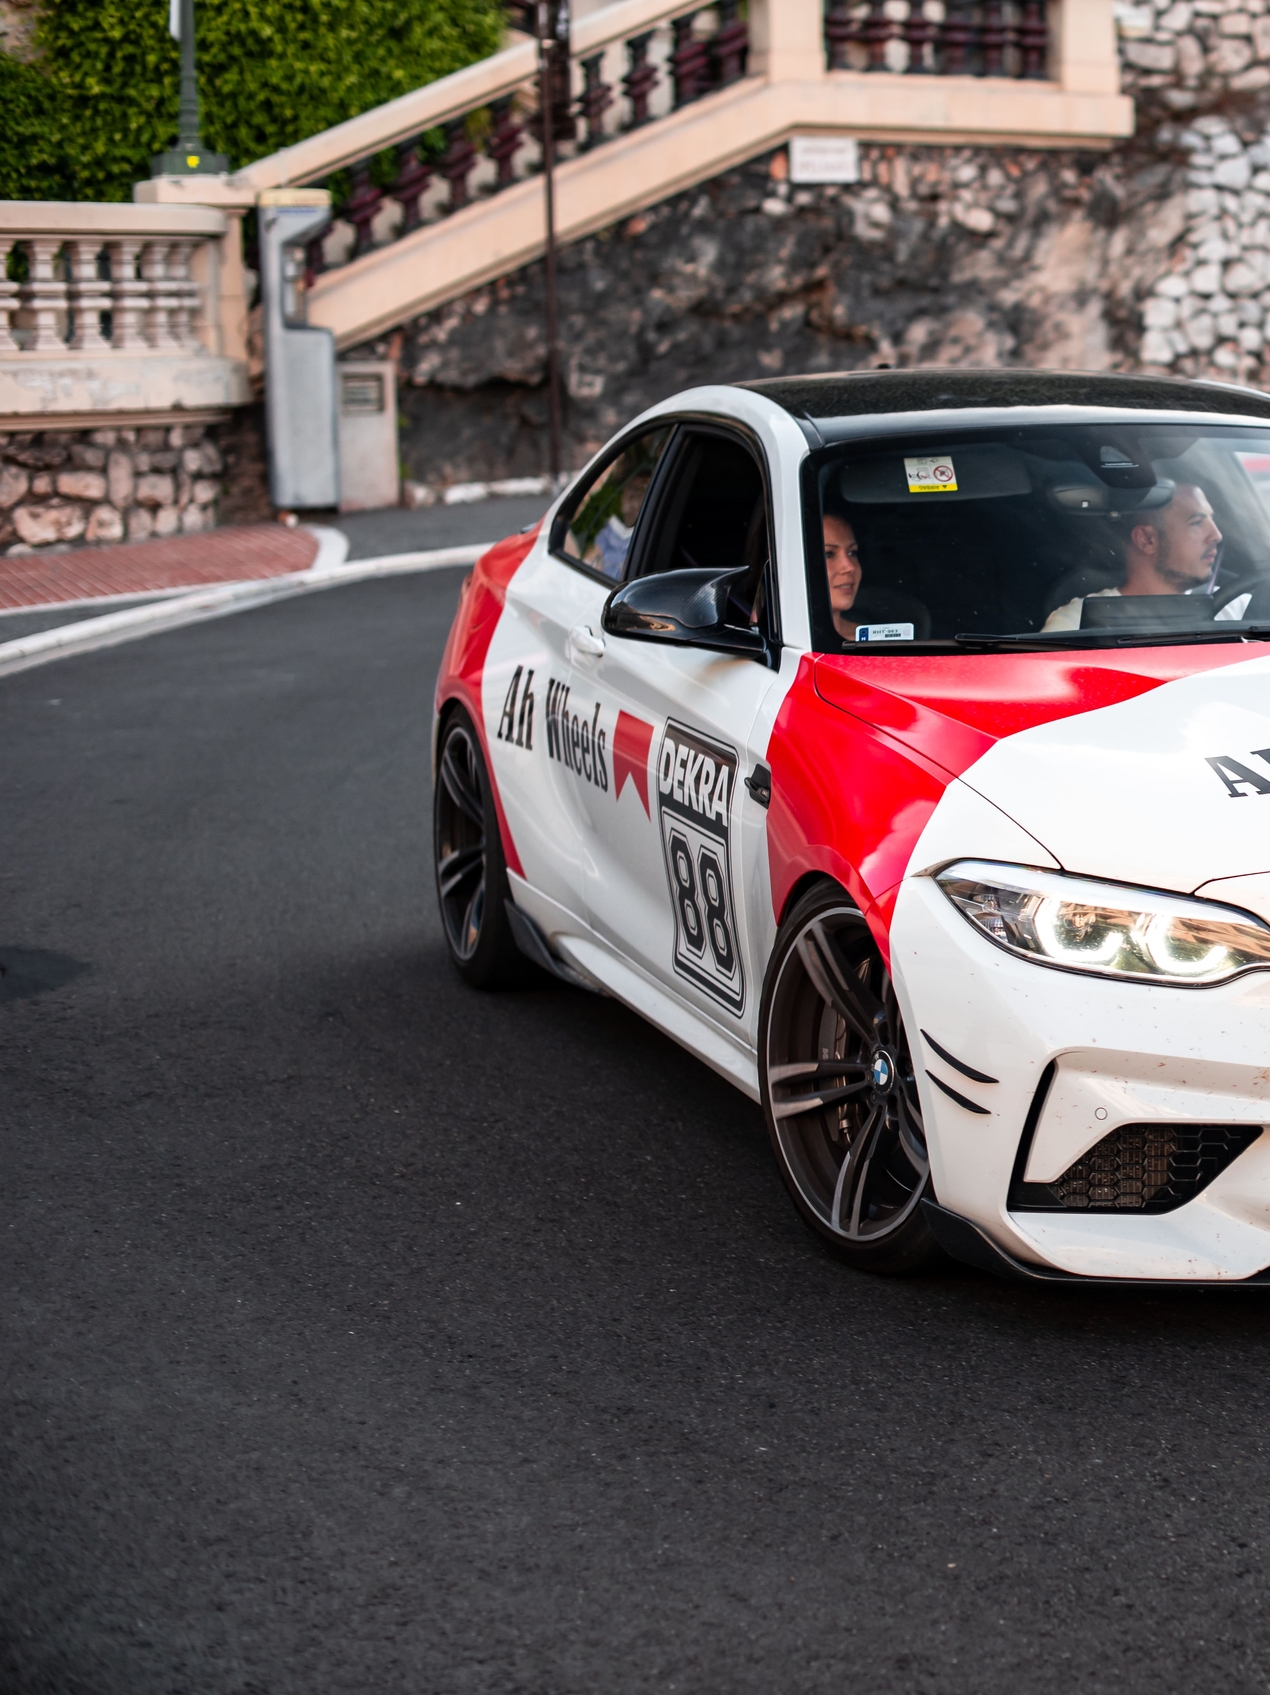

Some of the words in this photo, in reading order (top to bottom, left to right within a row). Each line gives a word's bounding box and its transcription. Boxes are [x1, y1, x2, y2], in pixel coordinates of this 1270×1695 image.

[497, 665, 534, 751] Ah
[545, 677, 608, 792] Wheels
[658, 738, 730, 828] DEKRA
[668, 827, 738, 982] 88
